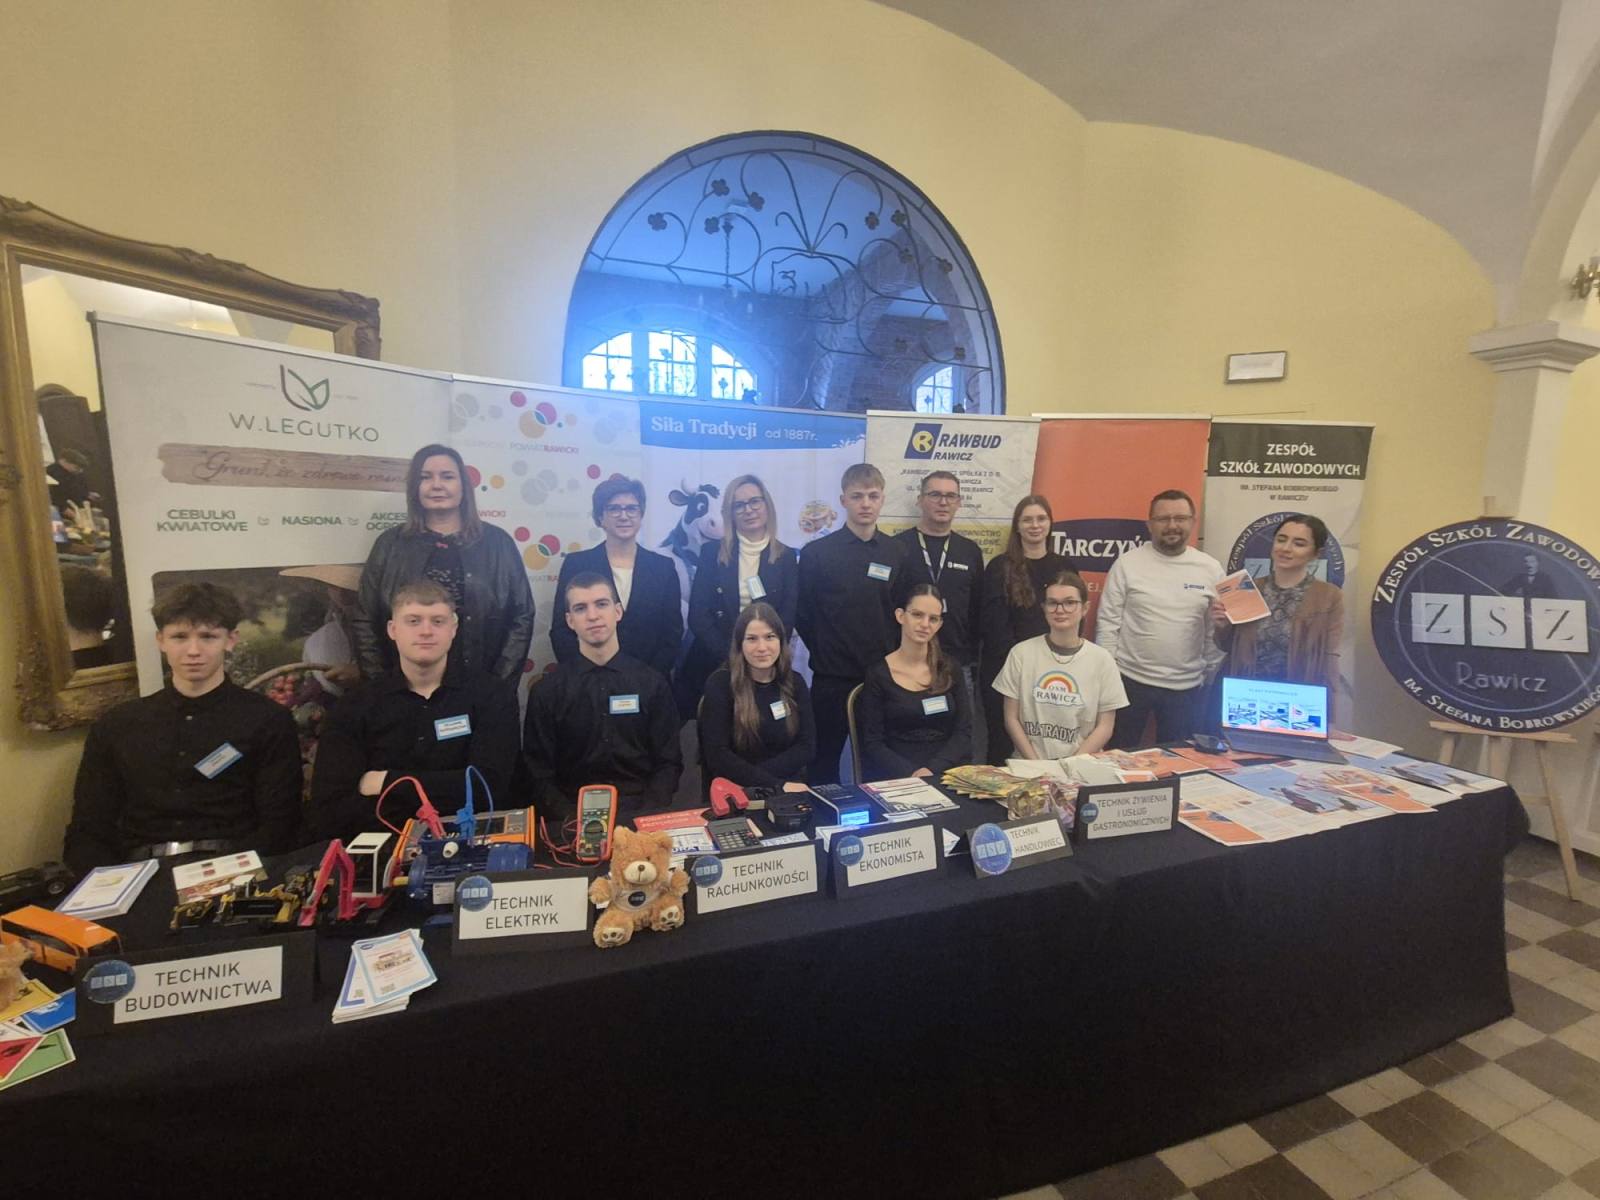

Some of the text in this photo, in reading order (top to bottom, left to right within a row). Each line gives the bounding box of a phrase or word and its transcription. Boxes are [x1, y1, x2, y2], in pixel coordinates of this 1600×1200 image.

[651, 416, 684, 433] Siła
[688, 418, 757, 441] Tradycji
[764, 429, 781, 439] od
[938, 433, 1002, 449] RAWBUD
[1266, 442, 1317, 457] ZESPÓŁ
[933, 451, 974, 461] RAWICZ
[1219, 459, 1361, 476] SZKÓŁ ZAWODOWYCH
[167, 509, 237, 520] CEBULKI
[281, 515, 342, 526] NASIONA
[156, 520, 249, 532] KWIATOWE
[1051, 531, 1152, 557] TARCZYŃ
[1374, 545, 1428, 604] ZESPÓŁ
[1505, 523, 1600, 582] ZAWODOW
[1456, 661, 1548, 693] Rawicz
[1036, 691, 1077, 703] RAWICZ
[1427, 694, 1493, 727] STEFANA
[1500, 684, 1600, 729] BOBROWSKIEG
[1097, 796, 1130, 809] TECHNIK
[1122, 807, 1148, 817] USŁUG
[1010, 825, 1039, 840] TECHNIK
[1092, 817, 1169, 832] GASTRONOMICZNYCH
[867, 837, 912, 855] TECHNIK
[1015, 837, 1063, 853] HANDLOWIEC
[732, 858, 784, 878] TECHNIK
[859, 850, 925, 872] EKONOMISTA
[707, 870, 809, 899] RACHUNKOWOŚCI
[492, 894, 553, 911] TECHNIK
[486, 912, 559, 930] ELEKTRYK
[155, 961, 241, 986] TECHNIK
[125, 979, 273, 1013] BUDOWNICTWA
